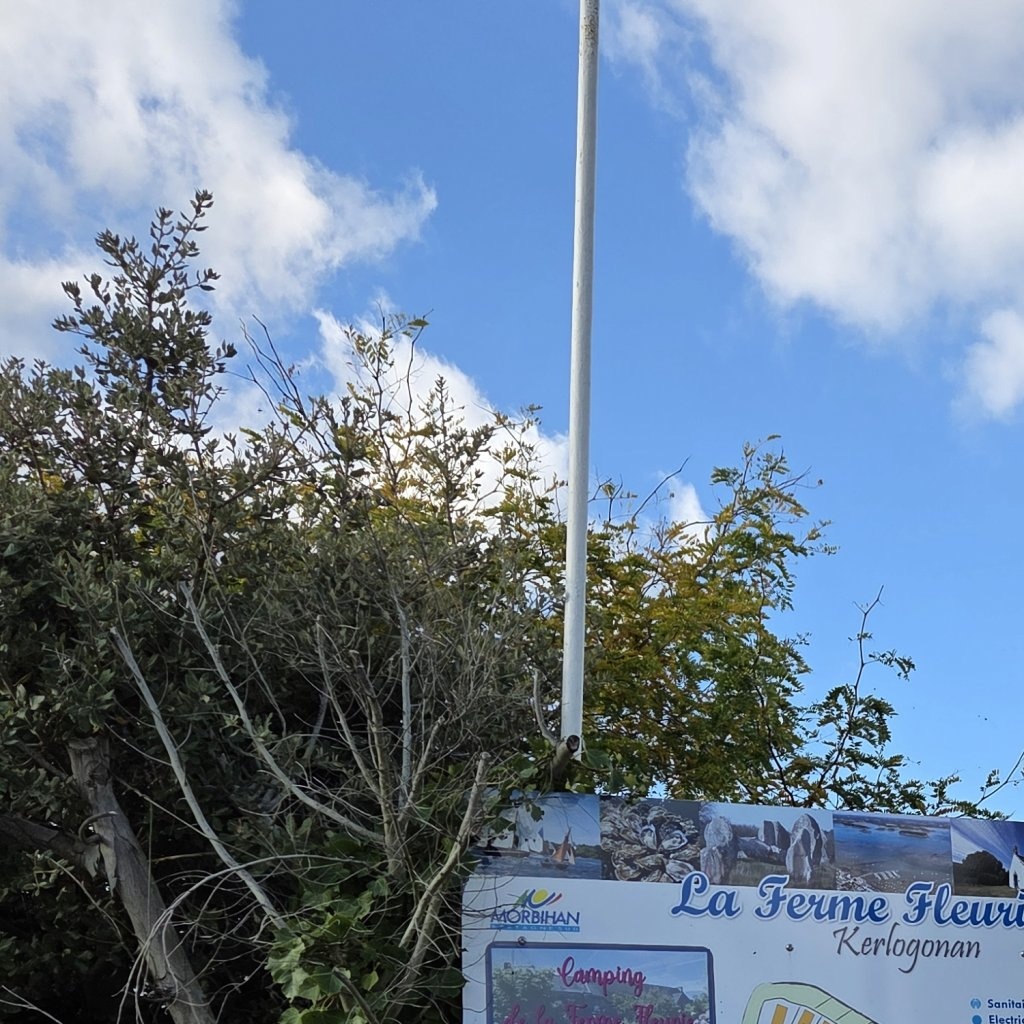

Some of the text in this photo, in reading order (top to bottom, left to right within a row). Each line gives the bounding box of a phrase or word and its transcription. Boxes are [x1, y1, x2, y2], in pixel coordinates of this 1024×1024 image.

[491, 909, 580, 925] MORBIHAN
[672, 872, 740, 917] La
[755, 875, 888, 922] Ferme
[833, 922, 980, 973] Kerlogonan
[557, 956, 646, 997] Camping
